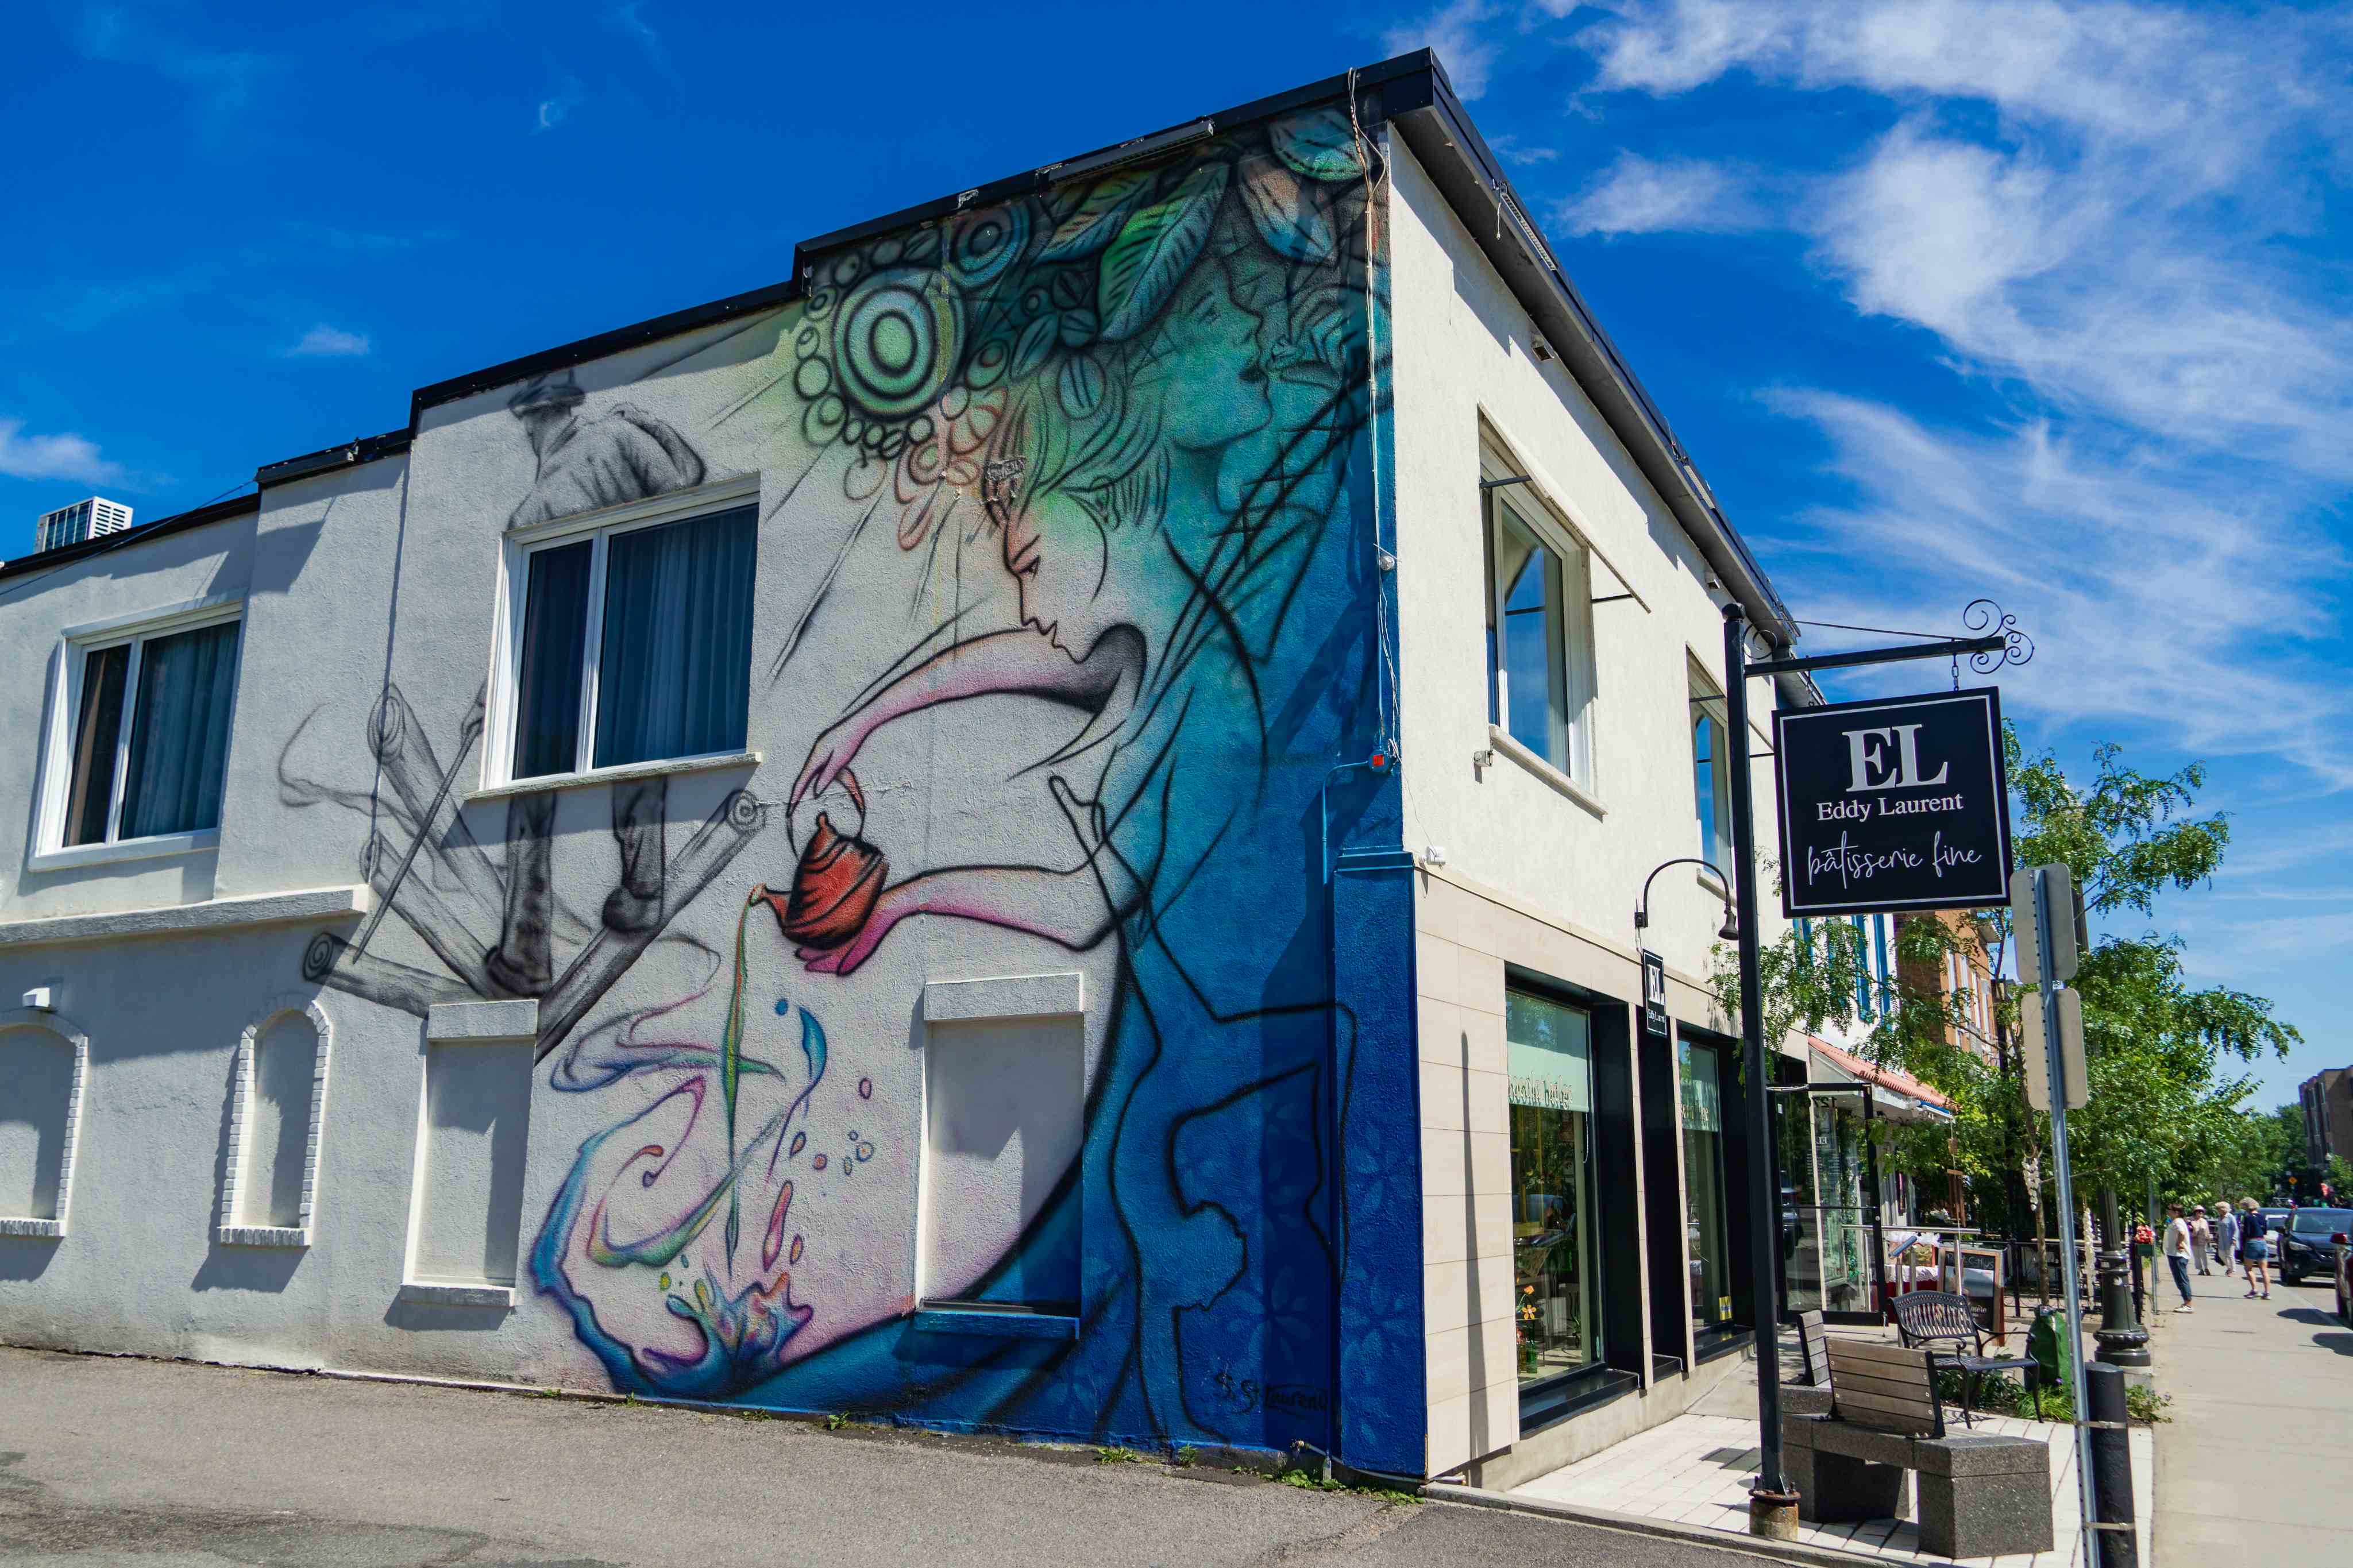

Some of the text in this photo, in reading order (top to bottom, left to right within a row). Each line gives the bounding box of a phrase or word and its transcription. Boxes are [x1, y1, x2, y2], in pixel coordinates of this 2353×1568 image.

[1842, 724, 1949, 791] EL
[1816, 793, 1964, 822] Eddy Laurent
[1807, 831, 1982, 889] pâtisserie fine
[1647, 964, 1664, 1006] EL
